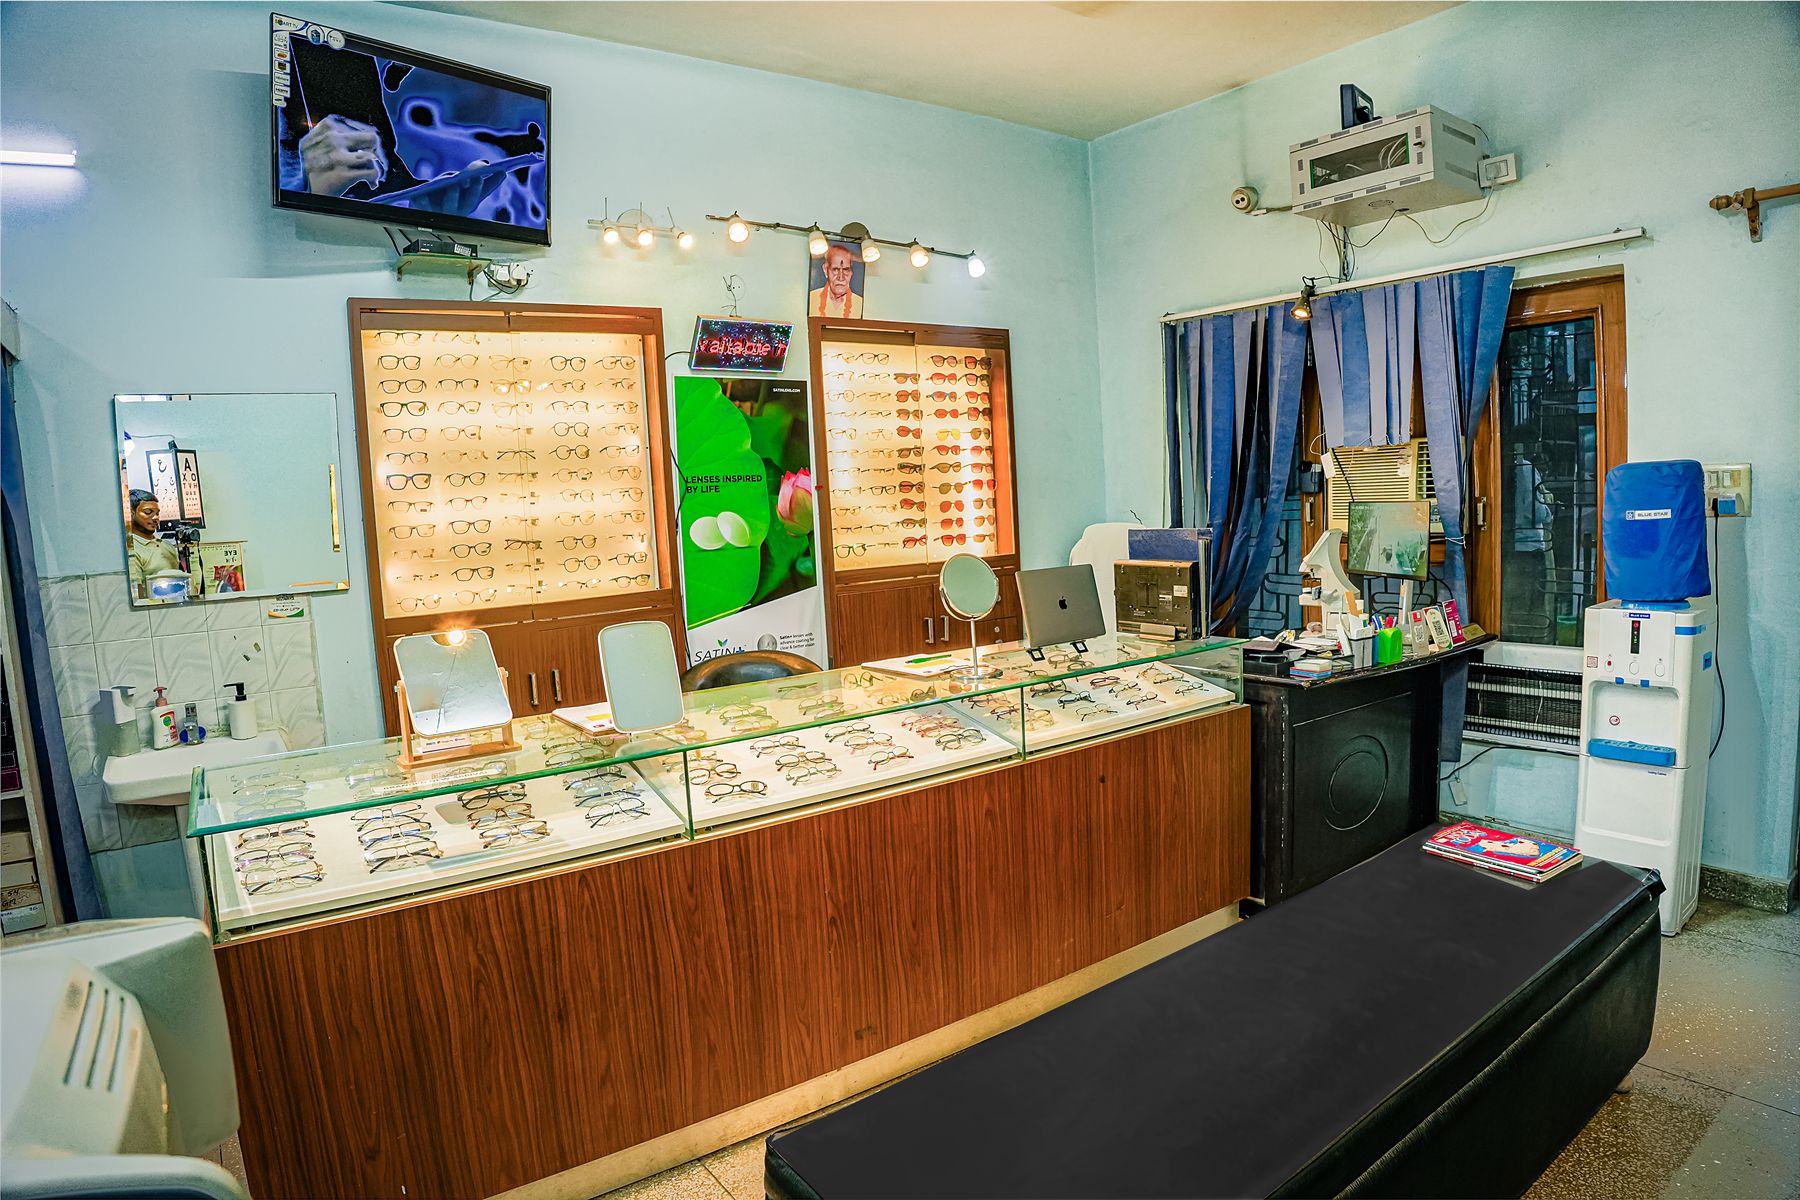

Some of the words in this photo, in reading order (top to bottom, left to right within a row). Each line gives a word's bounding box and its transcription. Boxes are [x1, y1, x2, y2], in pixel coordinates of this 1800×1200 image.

[687, 476, 720, 484] LENSES
[722, 475, 763, 483] INSPIRED
[686, 486, 698, 494] BY
[701, 485, 720, 493] LIFE
